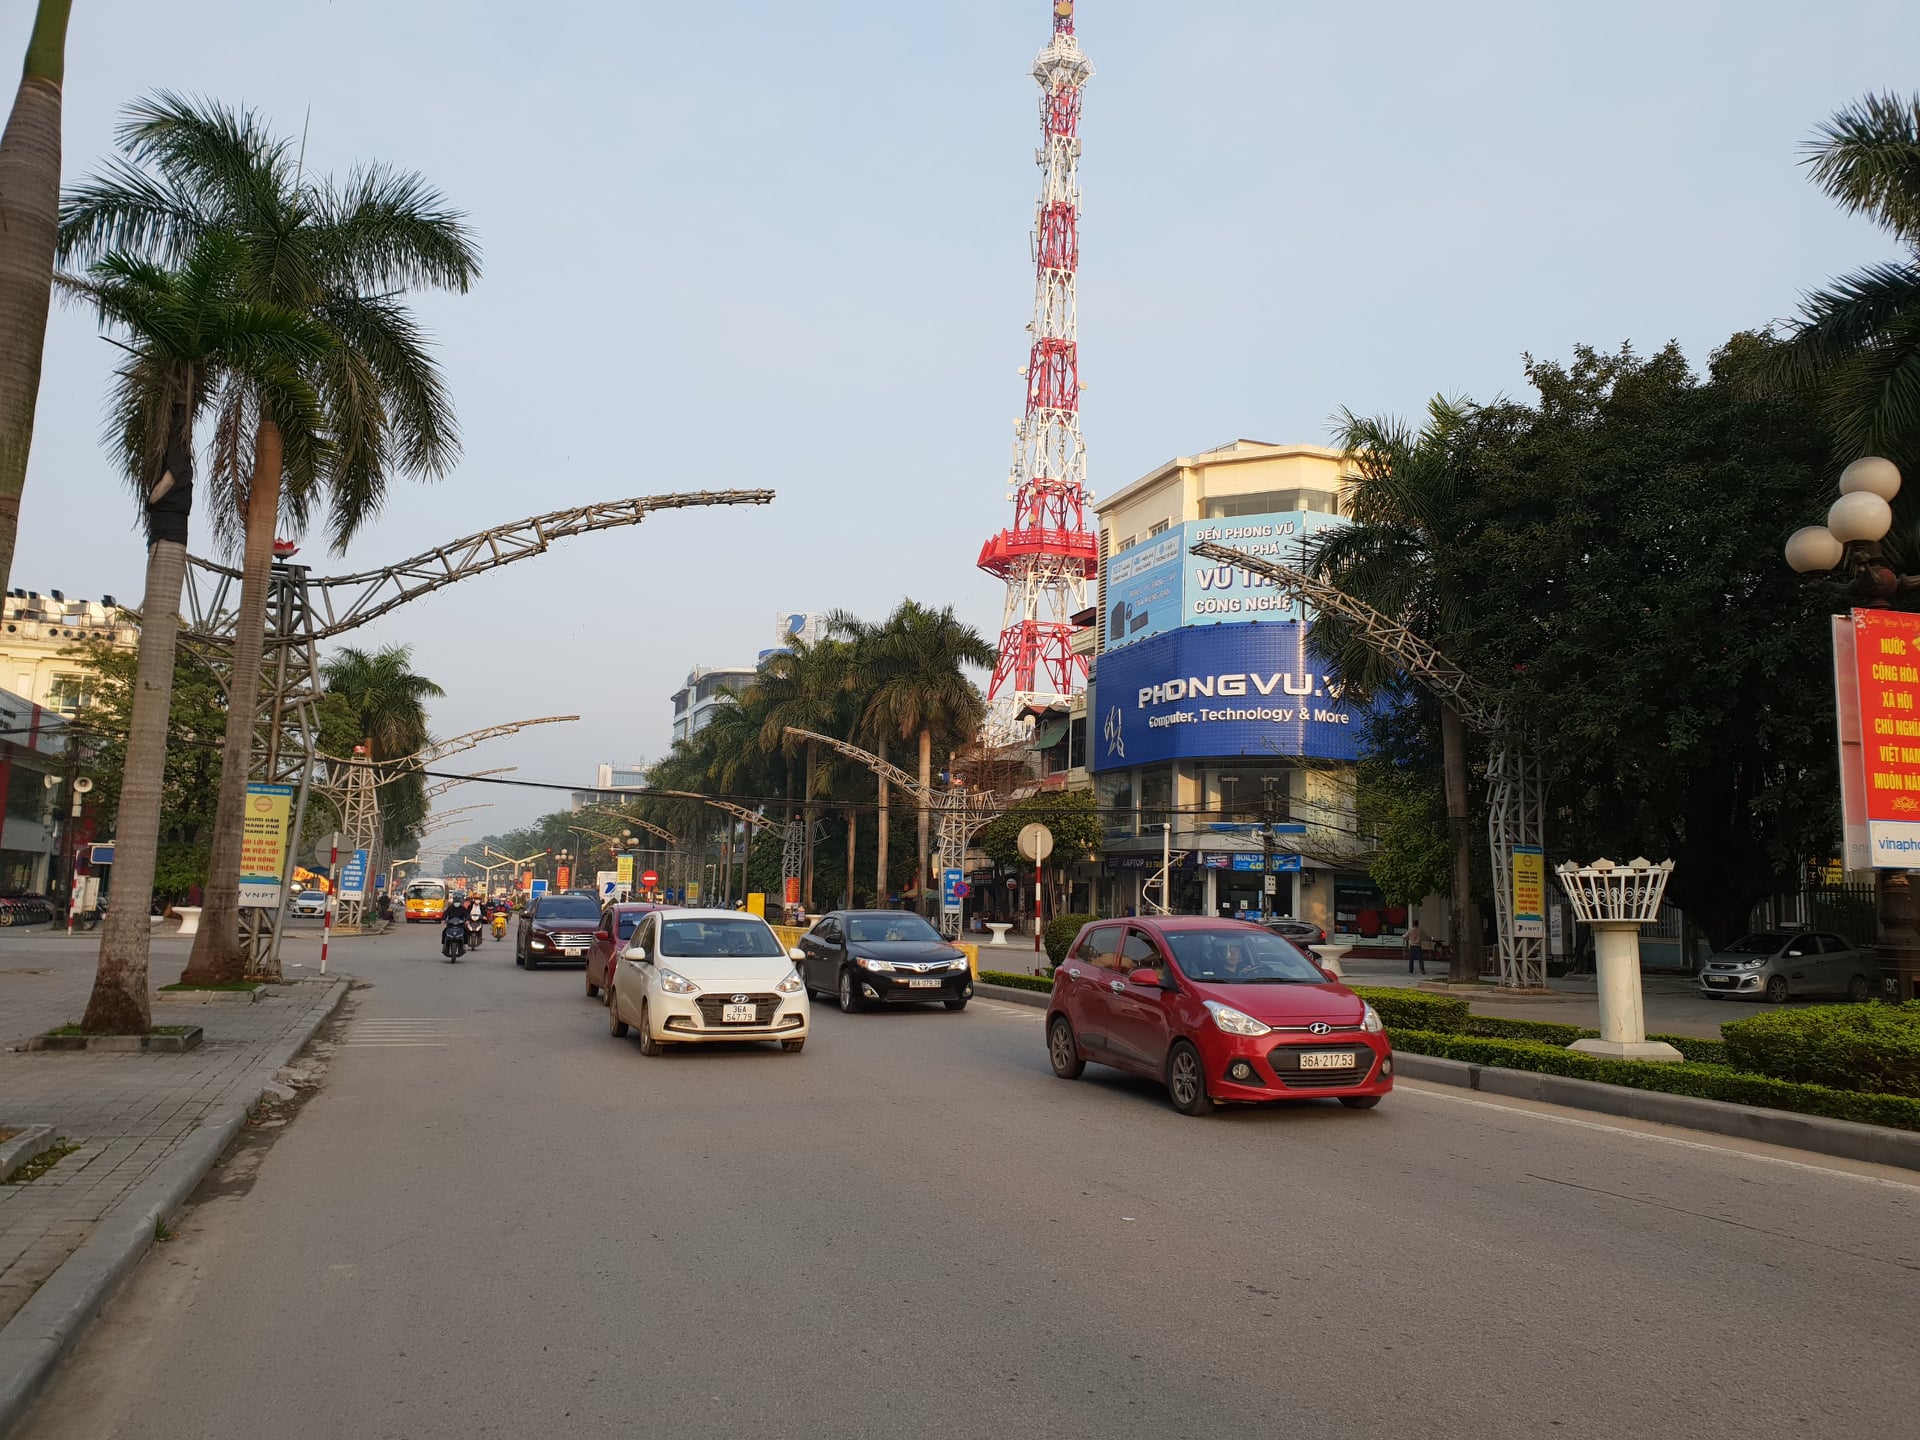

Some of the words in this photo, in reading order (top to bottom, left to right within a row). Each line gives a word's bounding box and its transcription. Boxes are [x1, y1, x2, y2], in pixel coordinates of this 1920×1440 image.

[1196, 526, 1222, 541] ĐẾN
[1225, 525, 1272, 539] PHONG
[1275, 521, 1295, 536] VŨ
[1251, 541, 1280, 556] PHÁ
[1196, 563, 1233, 591] VŨ
[1194, 597, 1241, 614] CÔNG
[1880, 636, 1906, 656] NƯỚC
[1872, 661, 1898, 684] CỘNG
[1882, 689, 1895, 708] XÃ
[1897, 691, 1913, 712] HỘI
[1149, 710, 1198, 728] Computer,
[1199, 706, 1294, 722] Technology
[1299, 708, 1310, 721] &
[1314, 708, 1350, 724] More
[1875, 713, 1893, 735] CHỦ
[1879, 743, 1900, 766] VIỆT
[1873, 770, 1902, 790] MUÔN
